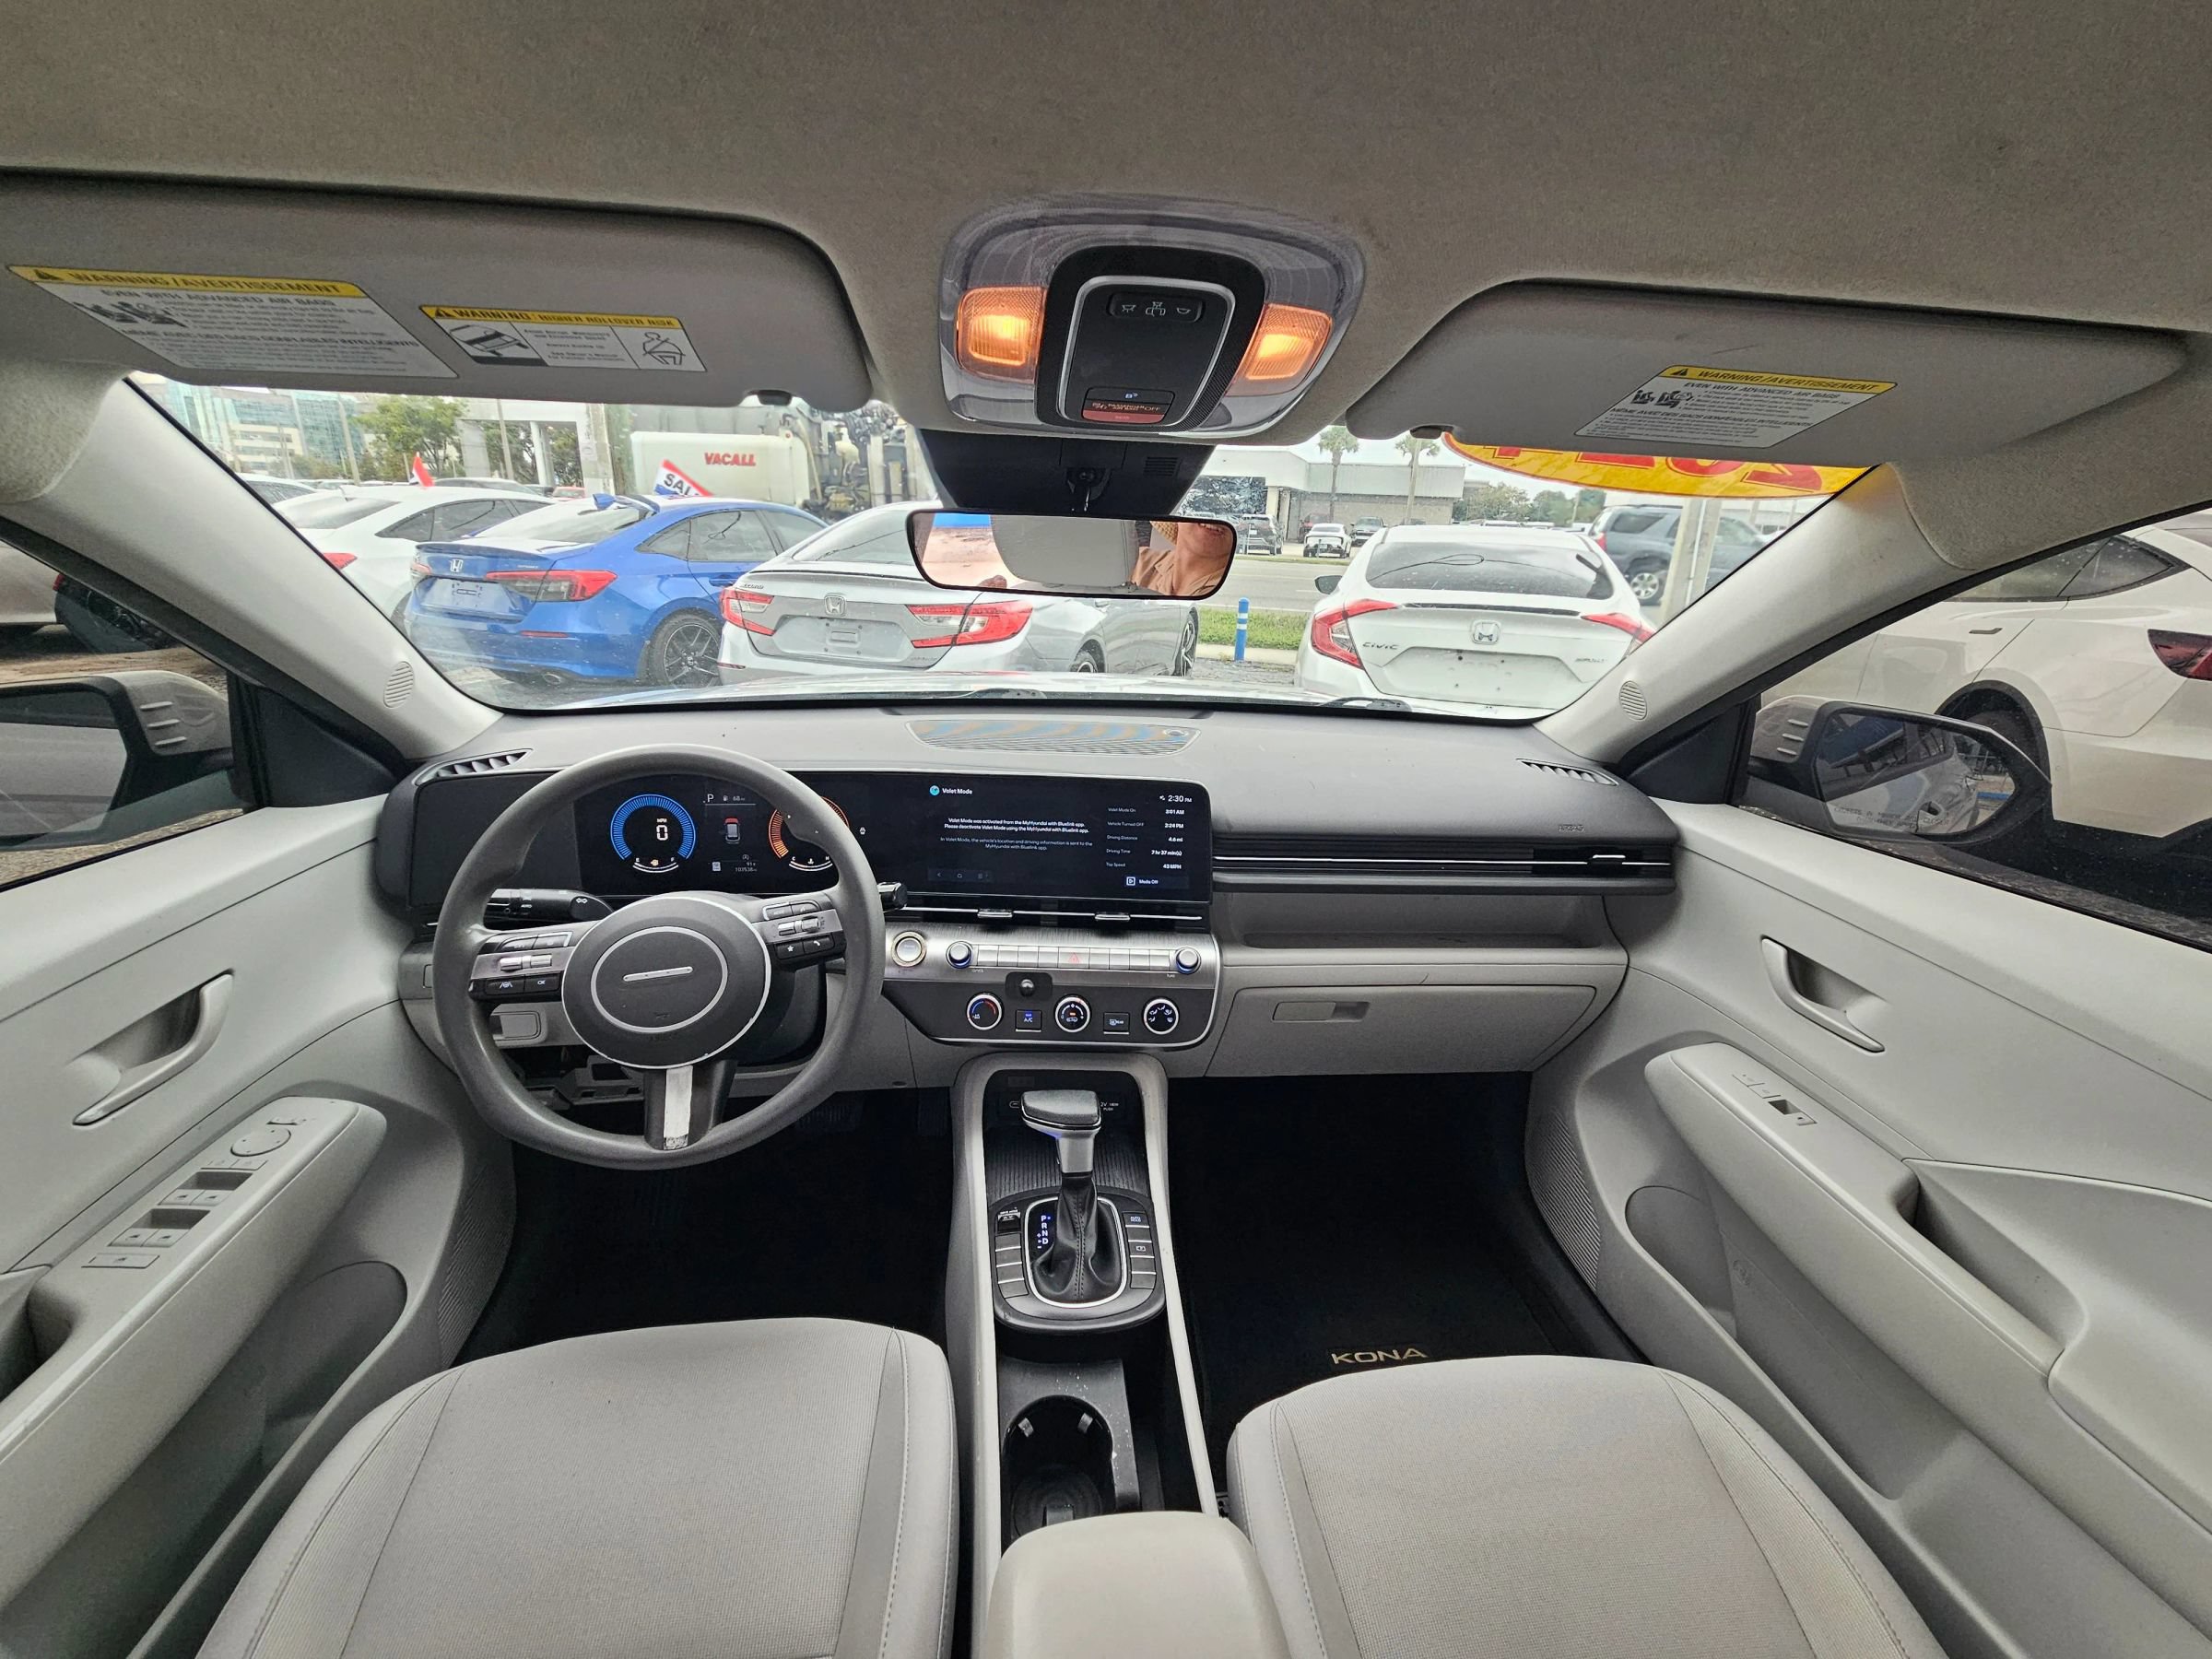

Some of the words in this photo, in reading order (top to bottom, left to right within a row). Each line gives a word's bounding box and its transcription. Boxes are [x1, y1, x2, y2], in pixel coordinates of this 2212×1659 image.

[704, 453, 756, 466] VACALL
[664, 473, 700, 497] SAL
[707, 794, 714, 803] P
[656, 824, 668, 841] 0
[1041, 1237, 1049, 1245] D
[1330, 1347, 1430, 1365] KONA
